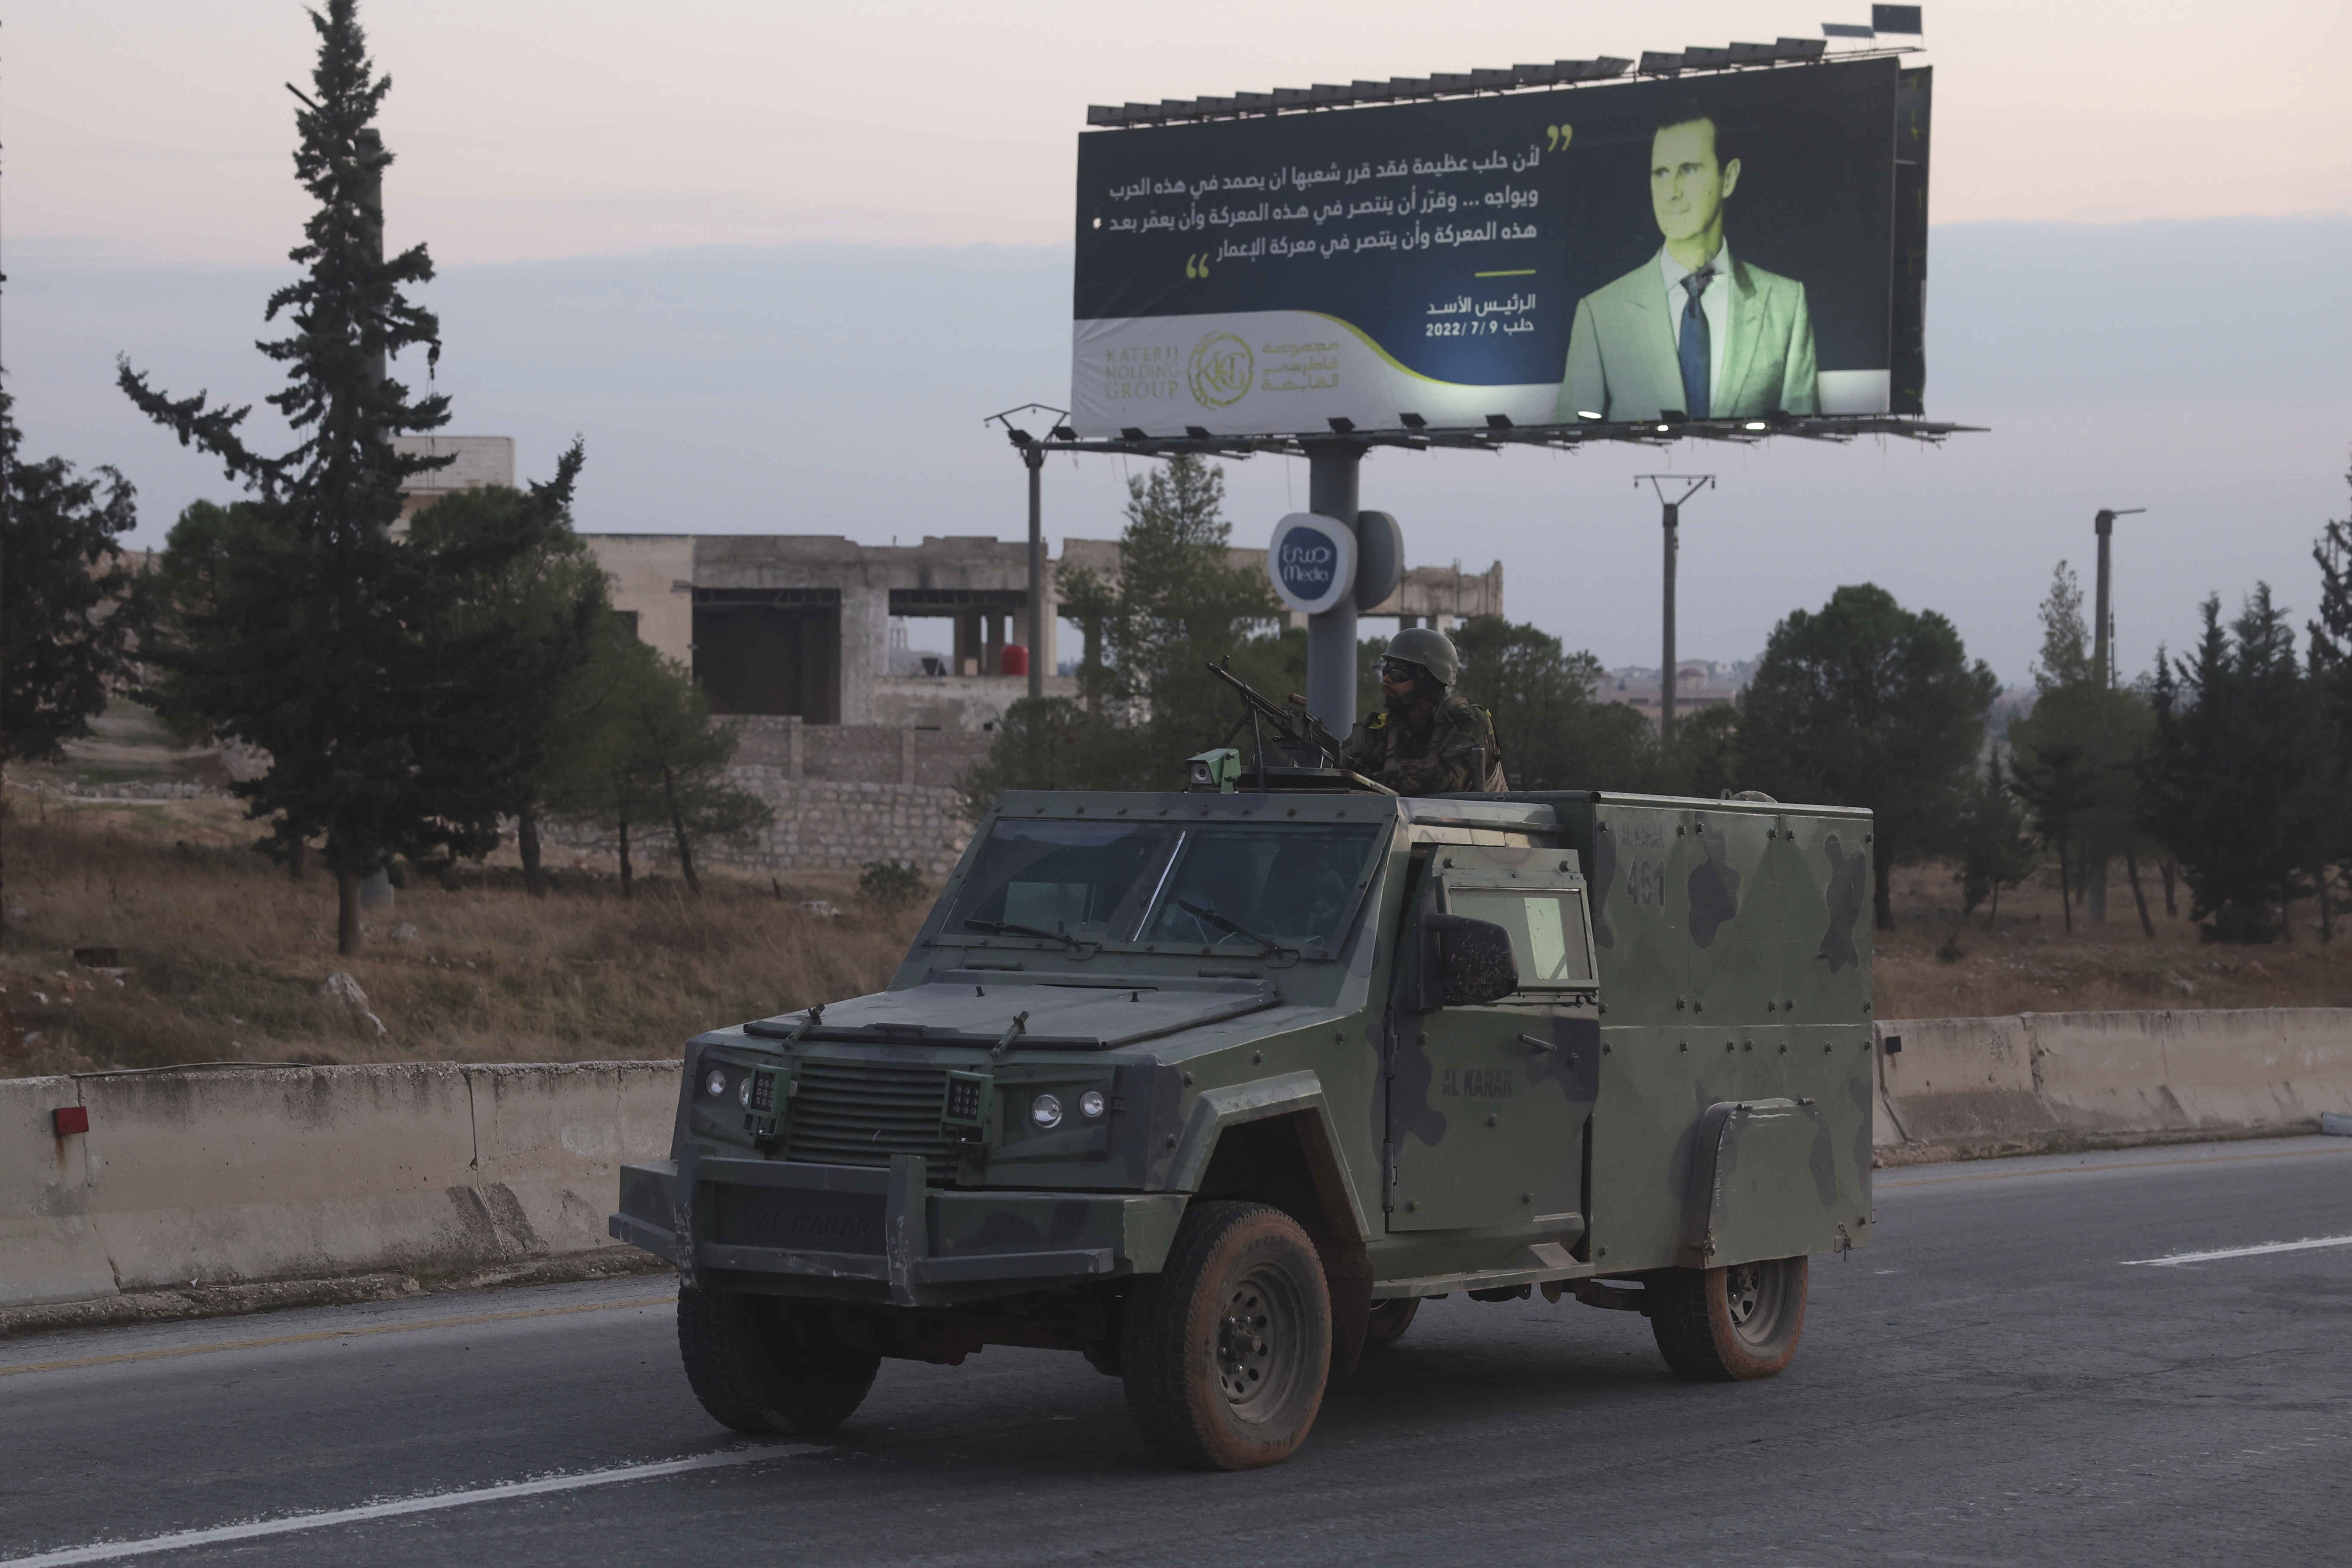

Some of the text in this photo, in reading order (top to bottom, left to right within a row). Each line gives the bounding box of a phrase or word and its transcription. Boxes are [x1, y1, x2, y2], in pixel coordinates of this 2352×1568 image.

[1376, 159, 1408, 177] فقد
[1413, 153, 1468, 177] عظيمة
[1473, 150, 1508, 174] حلب
[1513, 144, 1540, 172] لأن
[1223, 176, 1264, 191] يصمد
[1292, 162, 1340, 191] شعبها
[1345, 162, 1371, 185] قرر
[1110, 177, 1150, 201] الحرب
[1154, 178, 1186, 194] هذه
[1190, 174, 1218, 199] في
[1484, 185, 1539, 208] ويواجه
[1272, 203, 1309, 220] هذه
[1347, 196, 1393, 219] ينتصر
[1398, 185, 1416, 214] أن
[1178, 201, 1205, 230] وأن
[1209, 202, 1269, 227] المعركة
[1313, 199, 1343, 225] في
[1109, 217, 1137, 233] بعد
[1216, 220, 1537, 262] هذه المعركة وأن ينتصر في معركة الإعمار
[1426, 293, 1536, 317] الرئيس الأسد
[1503, 317, 1535, 336] حلب
[1106, 363, 1180, 379] HOLDING
[1105, 381, 1178, 400] GROUP
[1627, 859, 1665, 906] 461
[1442, 1069, 1513, 1097] AL KARAR
